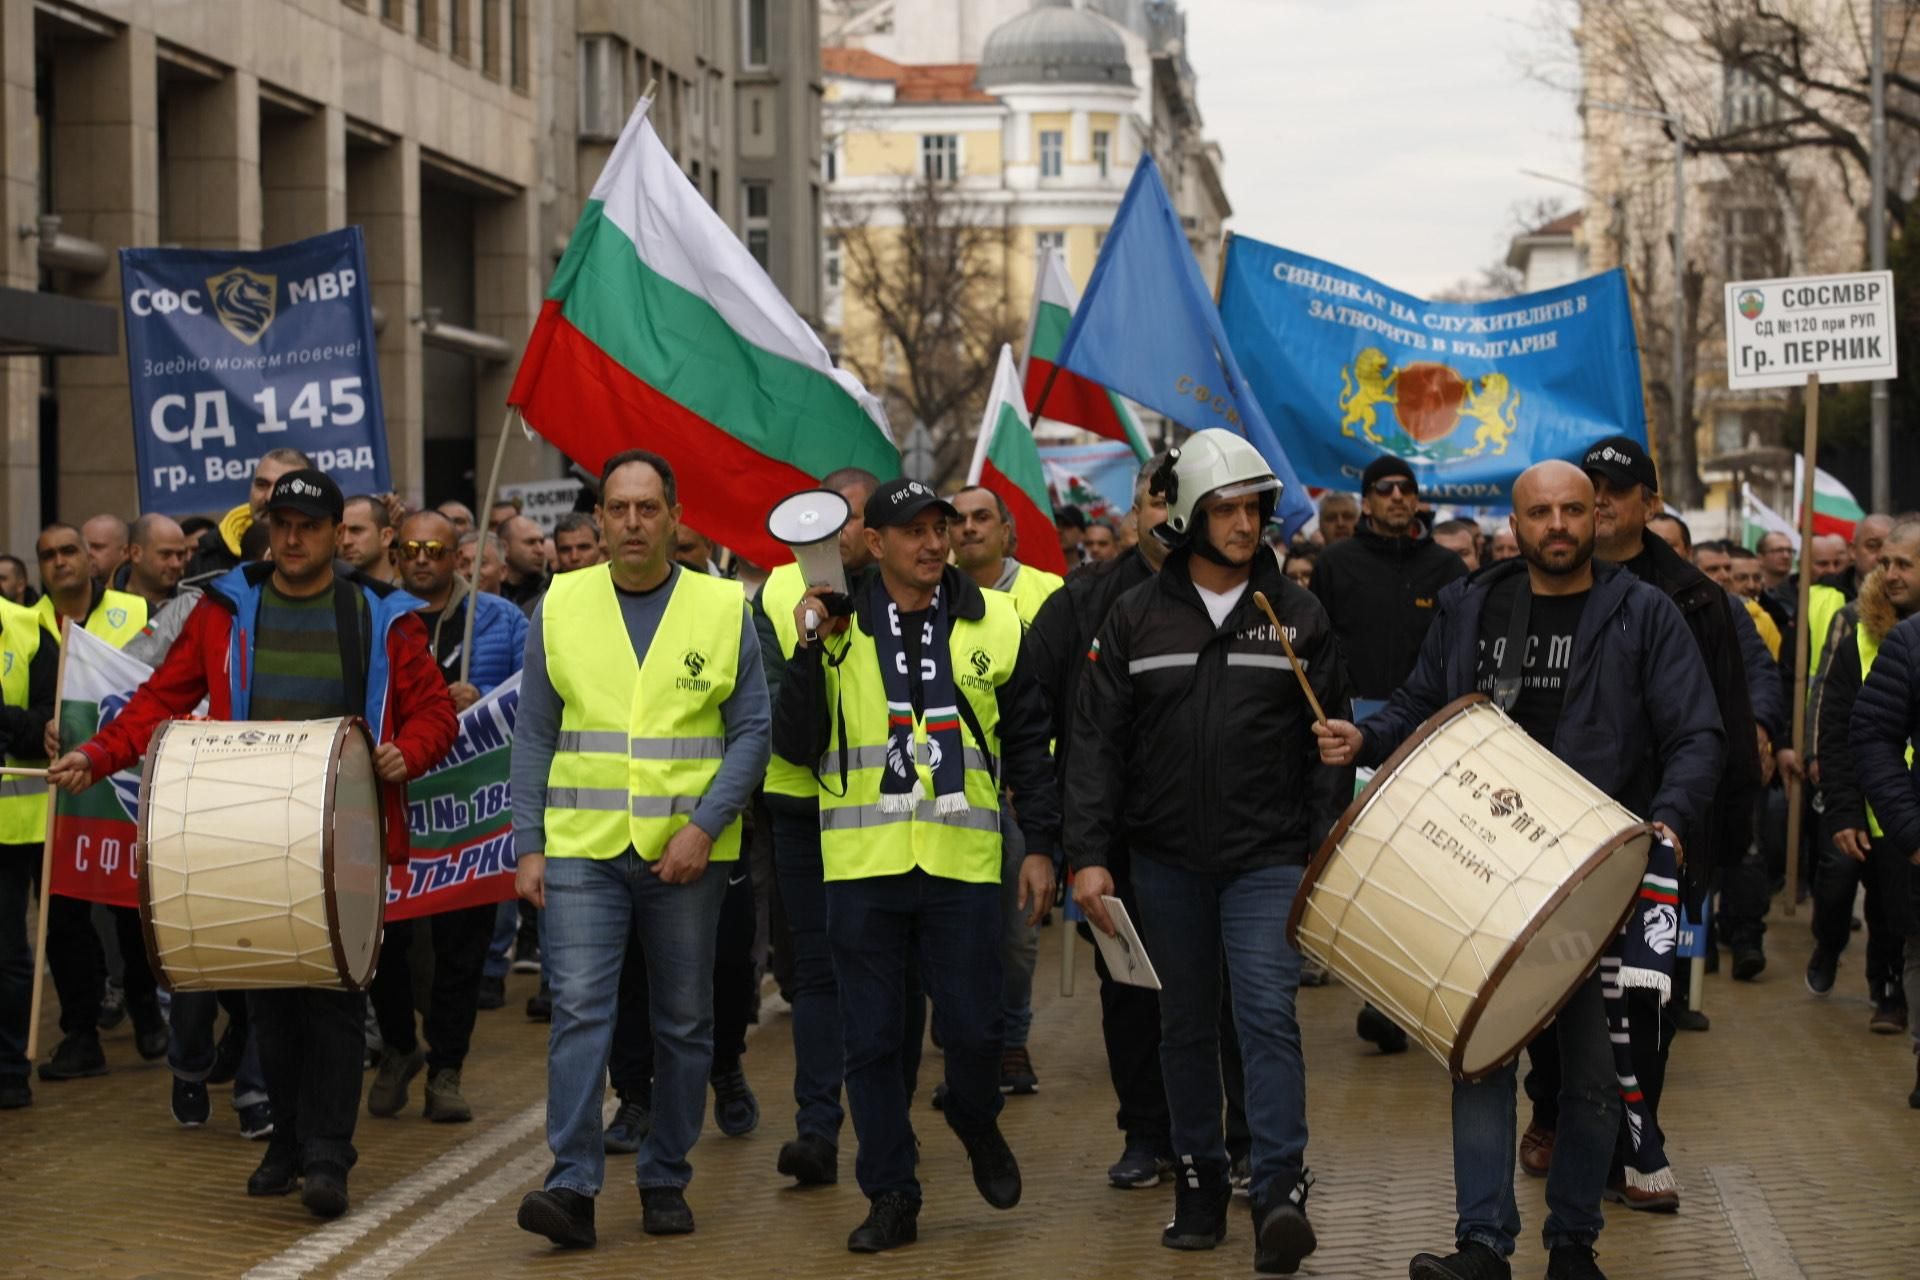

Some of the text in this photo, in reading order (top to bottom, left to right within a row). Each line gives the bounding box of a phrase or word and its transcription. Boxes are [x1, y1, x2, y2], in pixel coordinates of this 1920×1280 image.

[130, 269, 356, 316] СФС МВР
[1273, 262, 1588, 333] СИНДИКАТ НА СЛУЖИТЕЛИТЕ В
[1782, 282, 1880, 308] СФСМВР
[1308, 299, 1427, 350] ЗАТВОРИТЕ
[1430, 337, 1447, 352] В
[1755, 320, 1774, 337] СД
[1794, 317, 1817, 332] 120
[1822, 317, 1846, 333] при
[1850, 312, 1876, 329] РУП
[143, 339, 361, 377] Заедно можем повече!
[1741, 336, 1882, 372] Гр. ПЕРНИК
[150, 376, 365, 449] СД 145
[1175, 374, 1246, 433] СФСМ
[153, 467, 196, 492] гр.
[407, 832, 518, 899] ТЪРНО
[1421, 819, 1498, 884] ПЕРНИК
